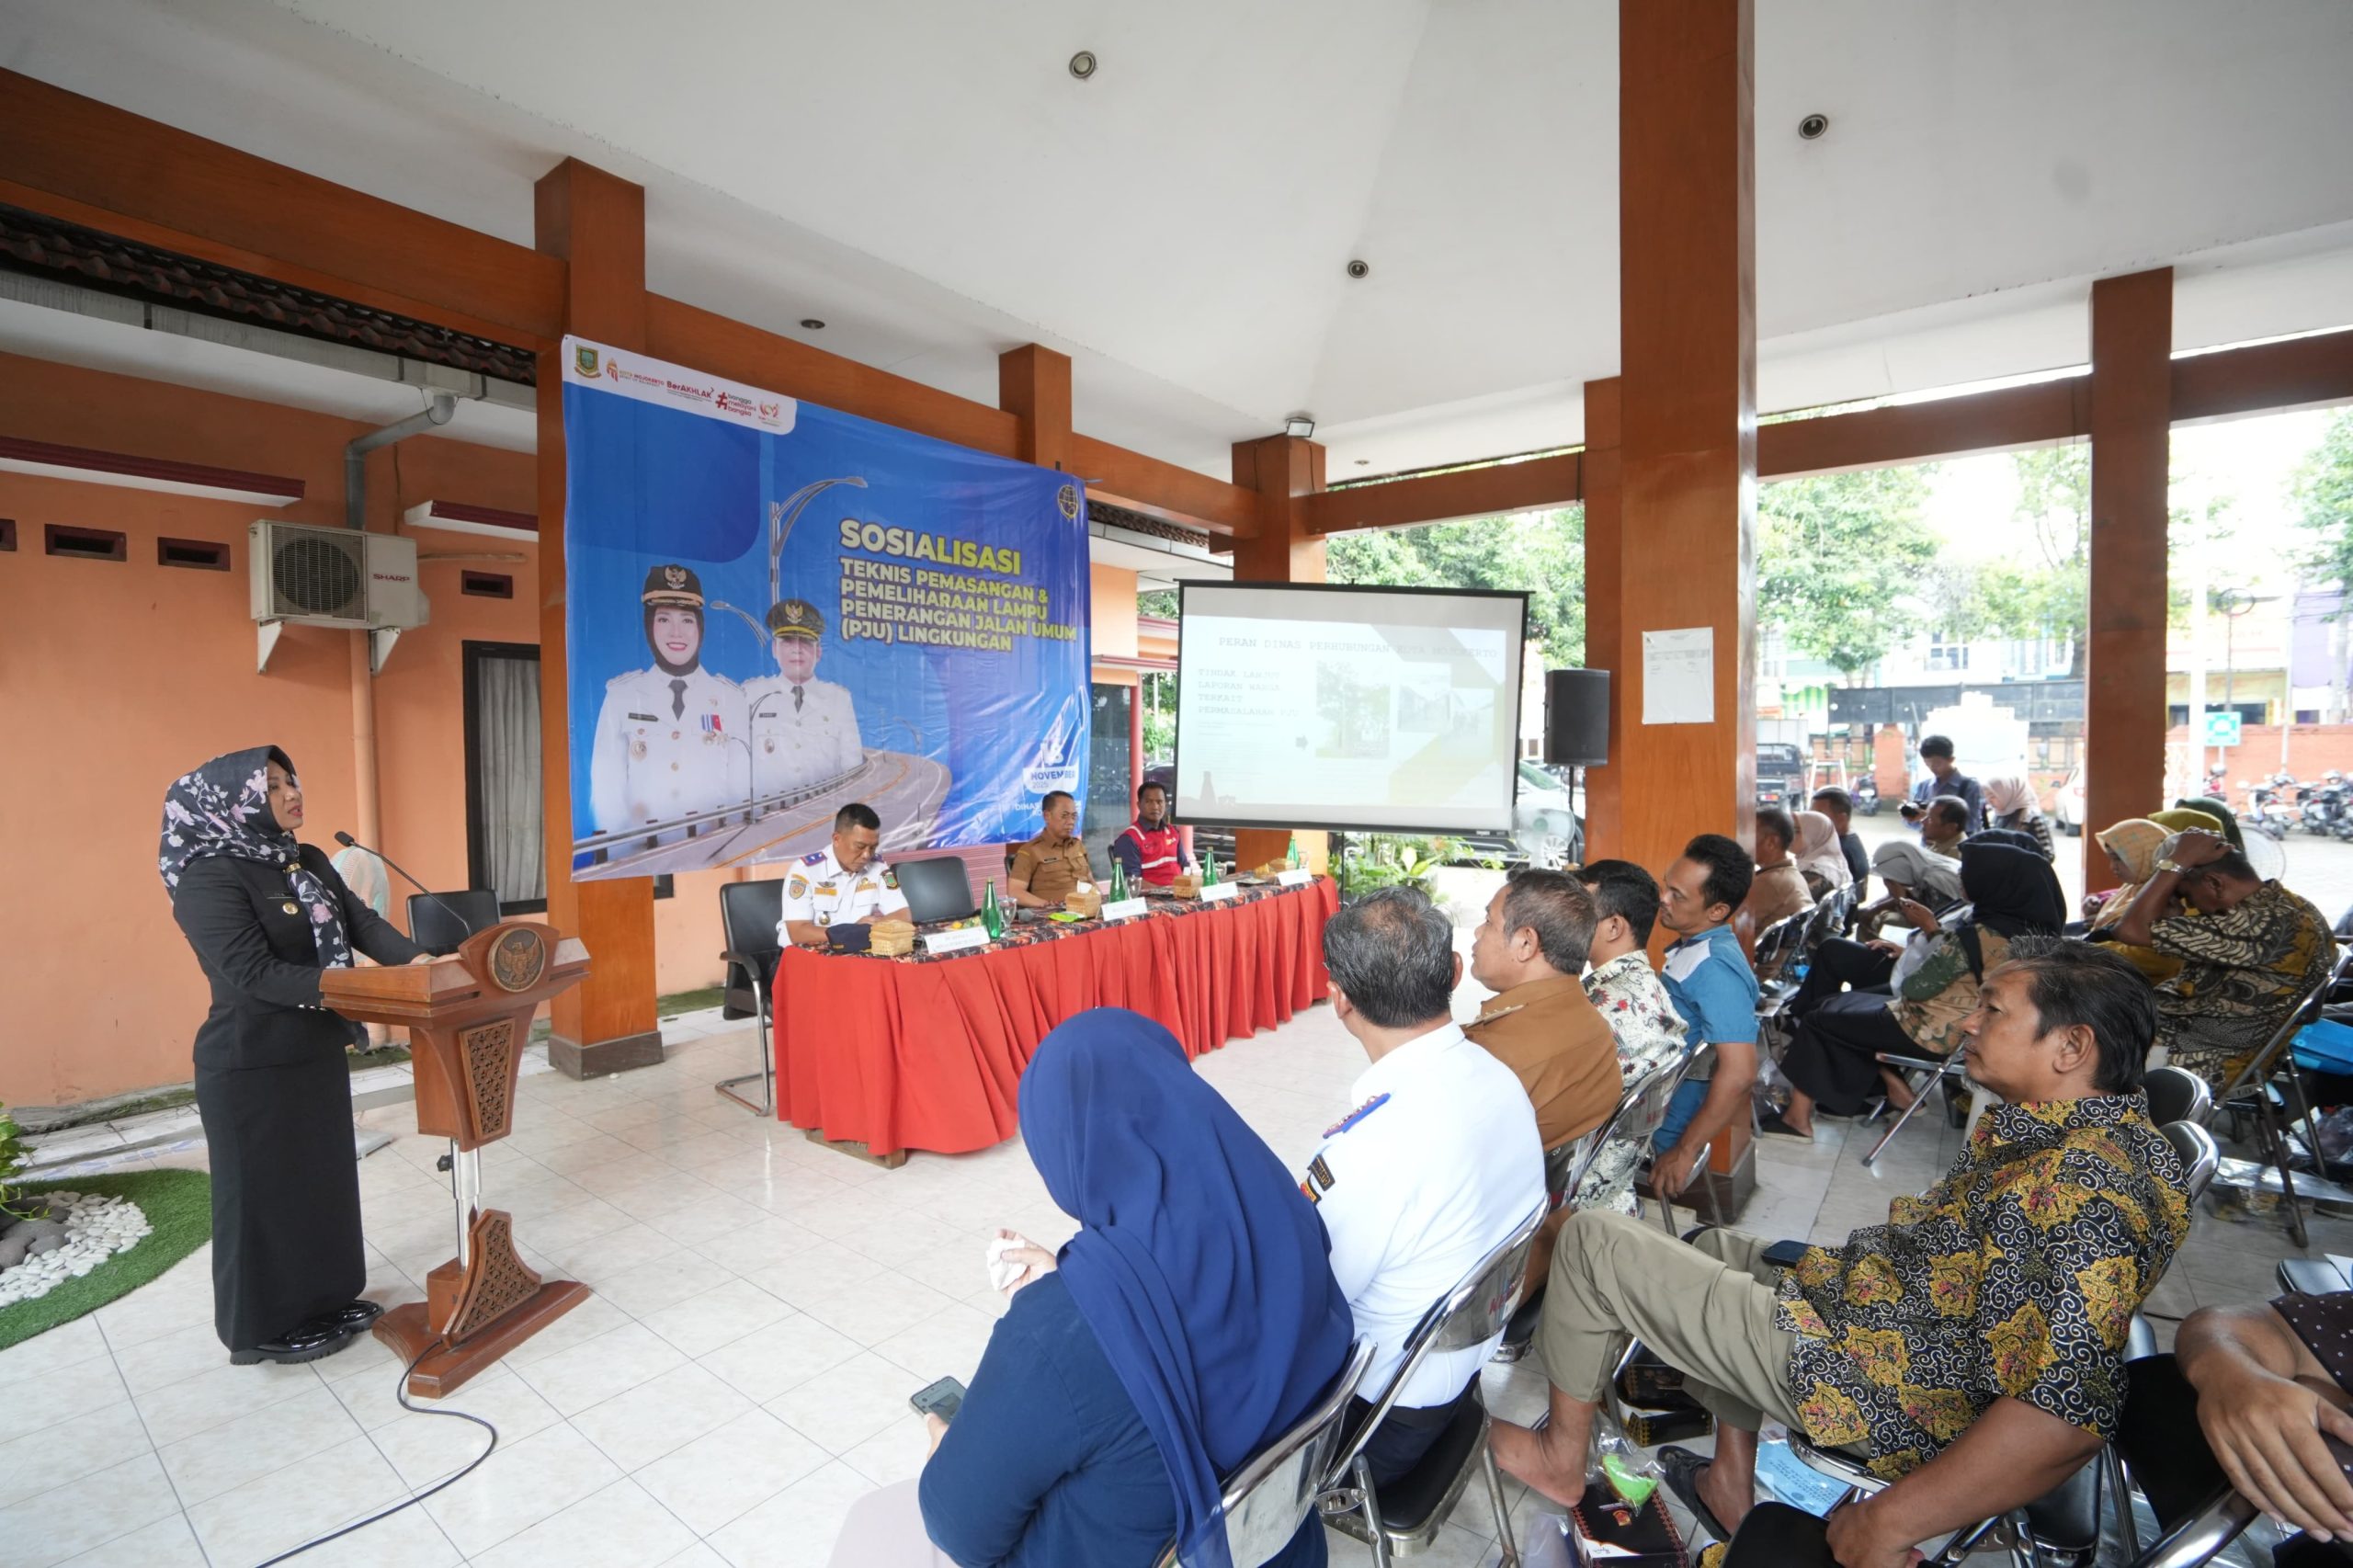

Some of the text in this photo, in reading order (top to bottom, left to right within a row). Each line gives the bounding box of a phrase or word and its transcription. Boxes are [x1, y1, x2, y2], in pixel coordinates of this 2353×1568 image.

[666, 381, 712, 399] BerAKHLAK
[728, 393, 752, 405] bangga
[728, 406, 752, 416] bangsa
[839, 518, 1021, 575] SOSIALISASI
[372, 573, 411, 582] SHARP
[840, 557, 1049, 603] TEKNIS PEMASANGAN &
[840, 578, 1048, 621] PEMELIHARAAN LAMPU
[840, 598, 1077, 642] PENERANGAN JALAN UMUM
[841, 618, 1013, 652] (PJU) LINGKUNGAN
[1218, 636, 1257, 647] PERAN
[1264, 639, 1302, 650] DINAS
[1309, 641, 1390, 653] PERHUBUNGAN
[1198, 668, 1236, 678] TINDAK
[1198, 681, 1243, 690] LAPORAN
